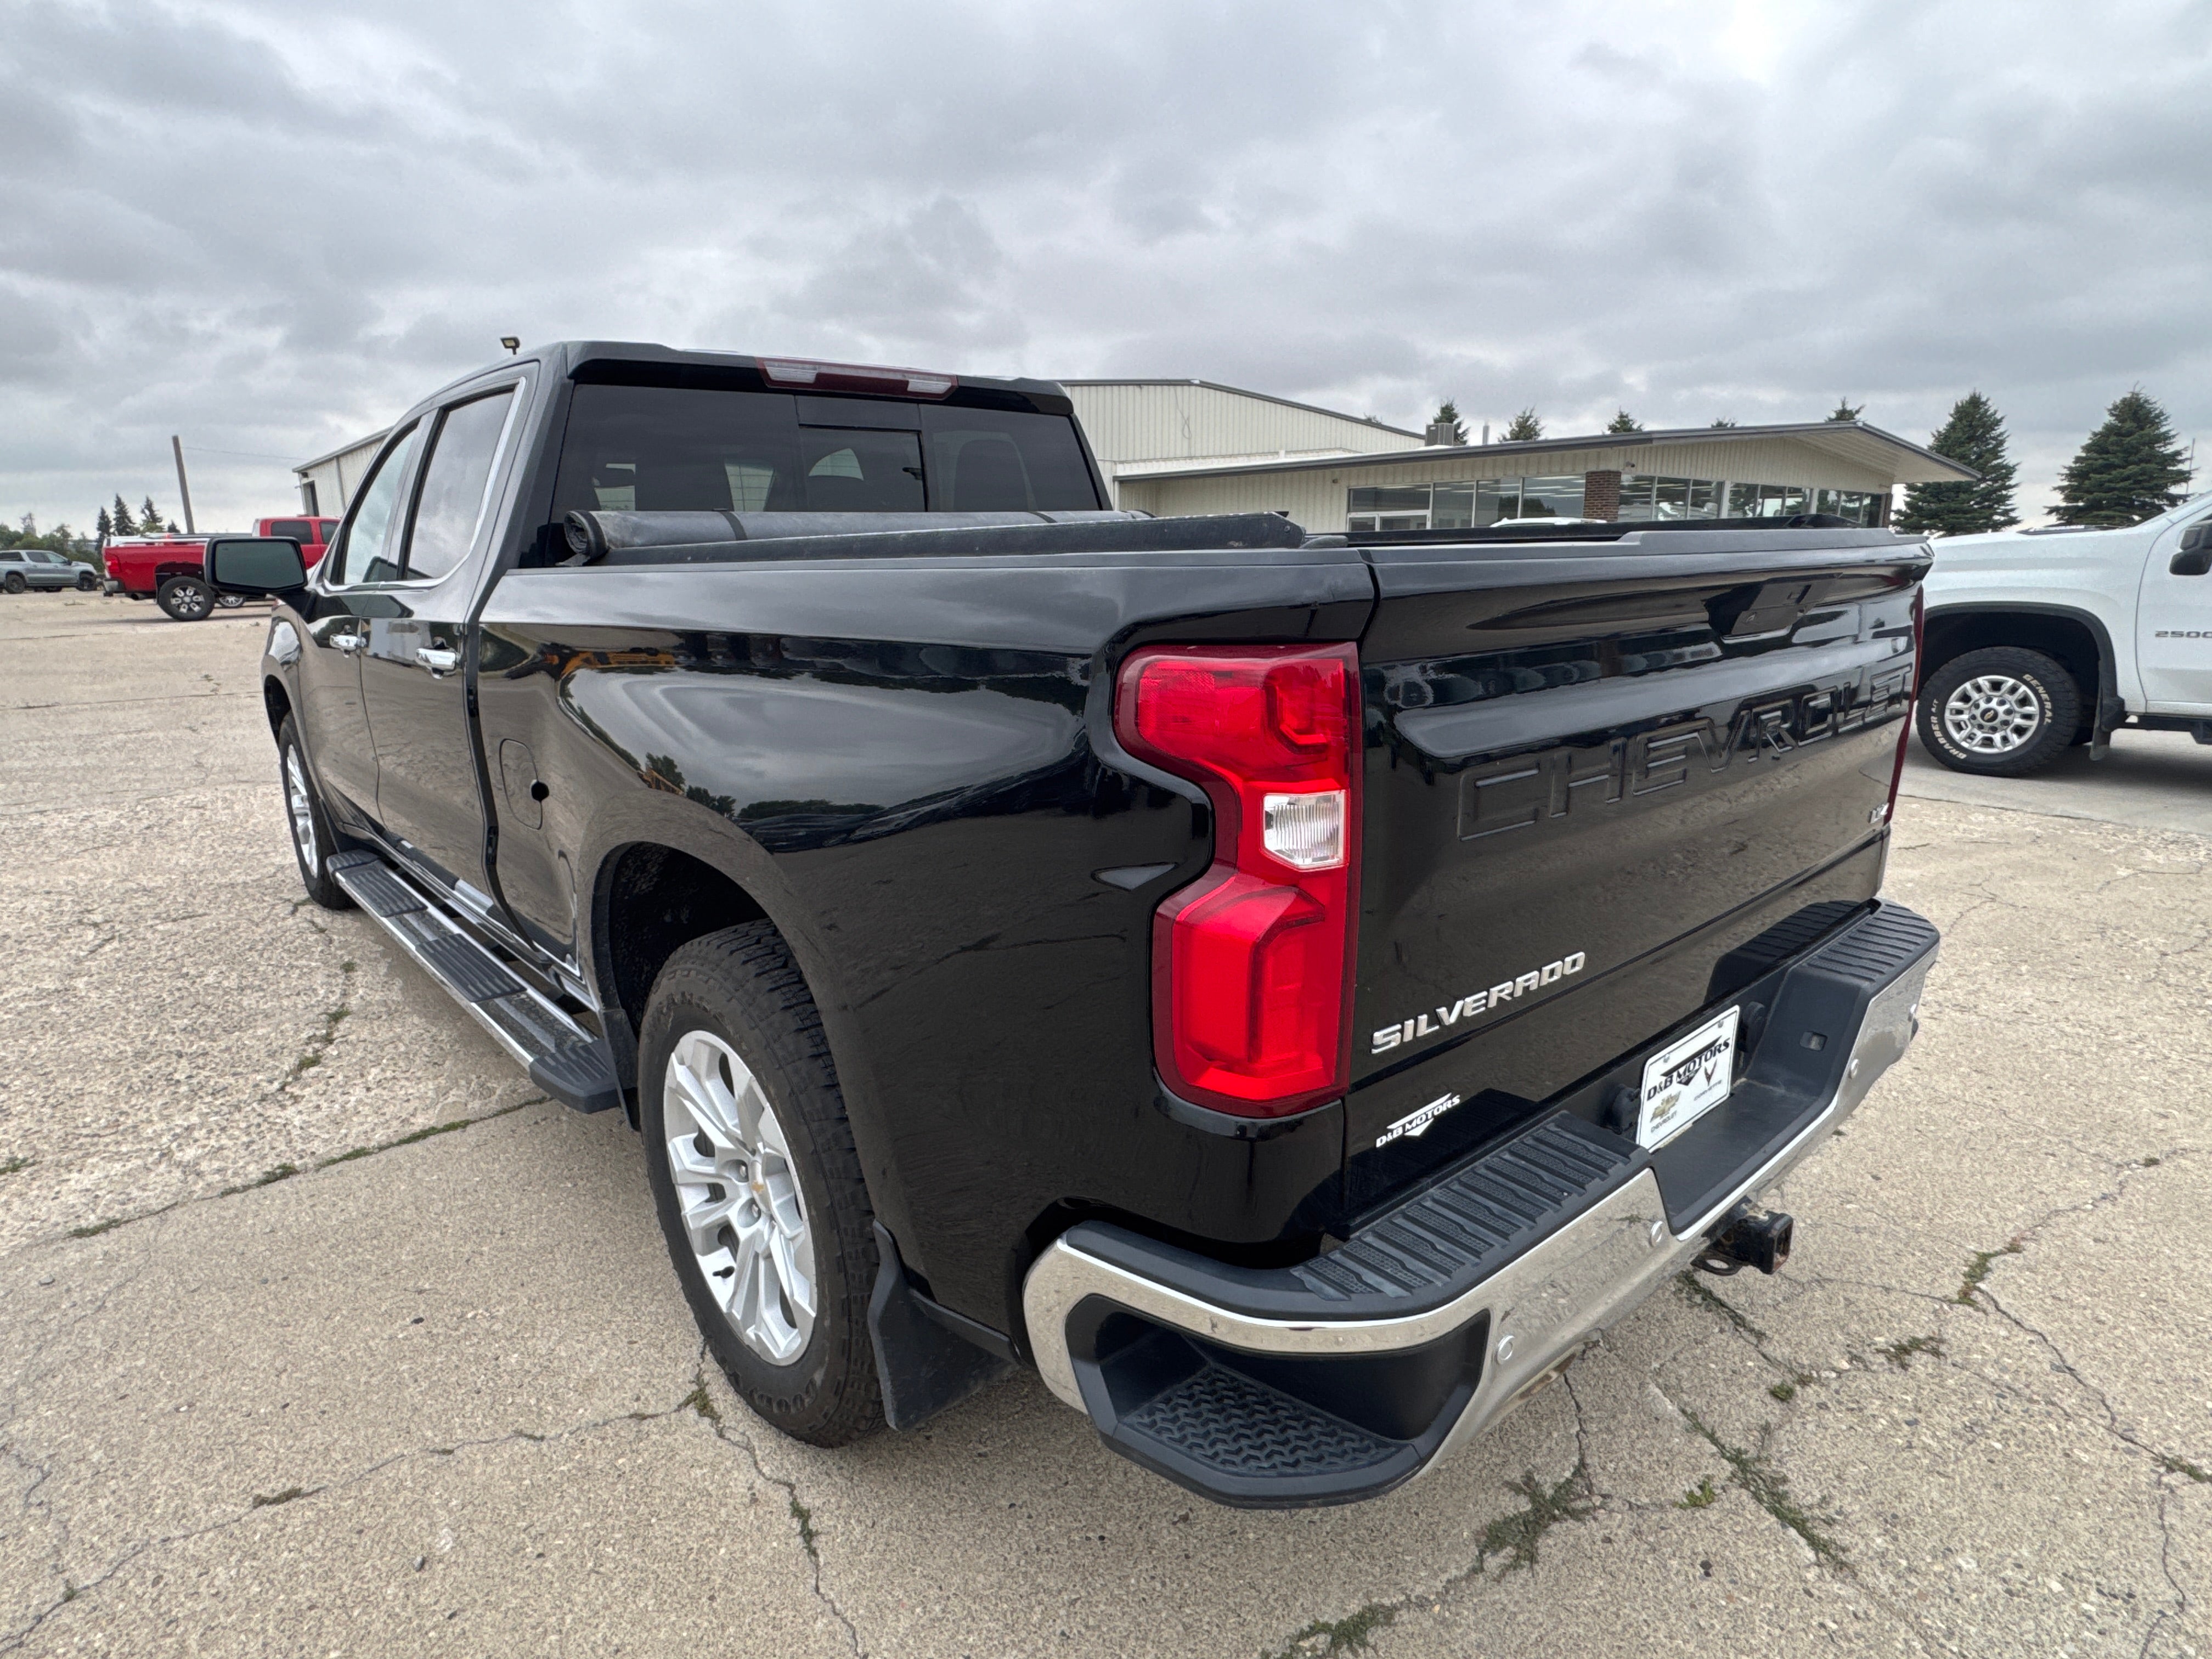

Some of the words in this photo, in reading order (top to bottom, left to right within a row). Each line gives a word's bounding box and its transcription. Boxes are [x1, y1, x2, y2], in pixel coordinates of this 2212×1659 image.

[2022, 674, 2052, 725] GENERAL
[1457, 662, 1913, 841] CHEVROLET
[1931, 715, 1967, 759] GRABBER
[1371, 951, 1585, 1054] SILVERADO
[1647, 1075, 1673, 1102] D&B
[1676, 1037, 1730, 1079] MOTORS
[1376, 1126, 1403, 1148] D&B
[1405, 1094, 1460, 1132] MOTORS
